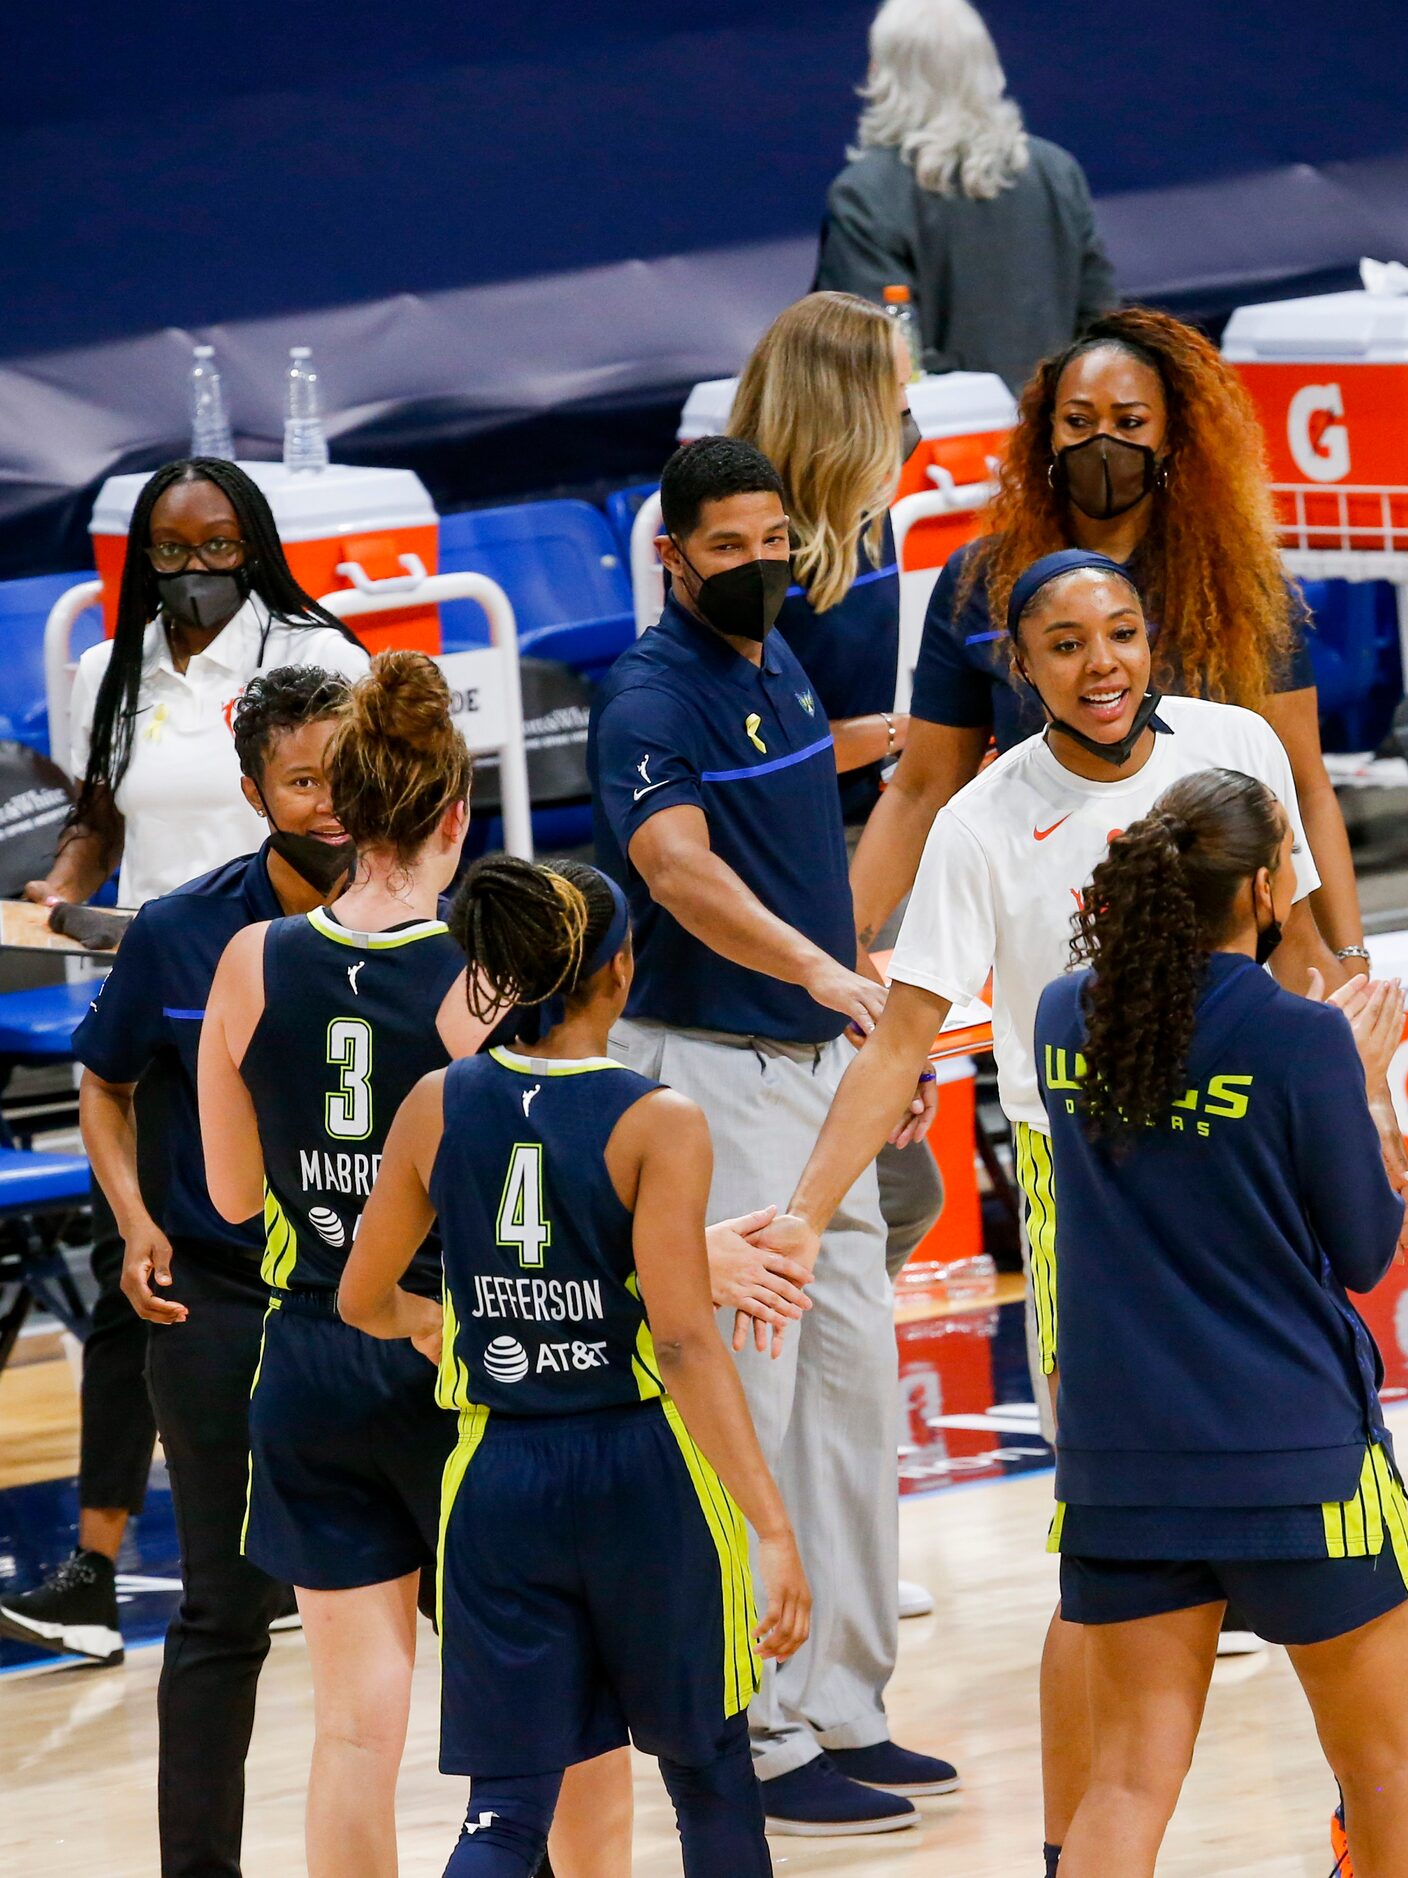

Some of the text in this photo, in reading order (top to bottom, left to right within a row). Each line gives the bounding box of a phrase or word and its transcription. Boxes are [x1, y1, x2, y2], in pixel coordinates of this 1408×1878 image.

[1286, 382, 1352, 483] G
[325, 1017, 373, 1141] 3
[496, 1142, 551, 1268] 4
[472, 1275, 604, 1322] JEFFERSON
[535, 1340, 610, 1375] AT&T
